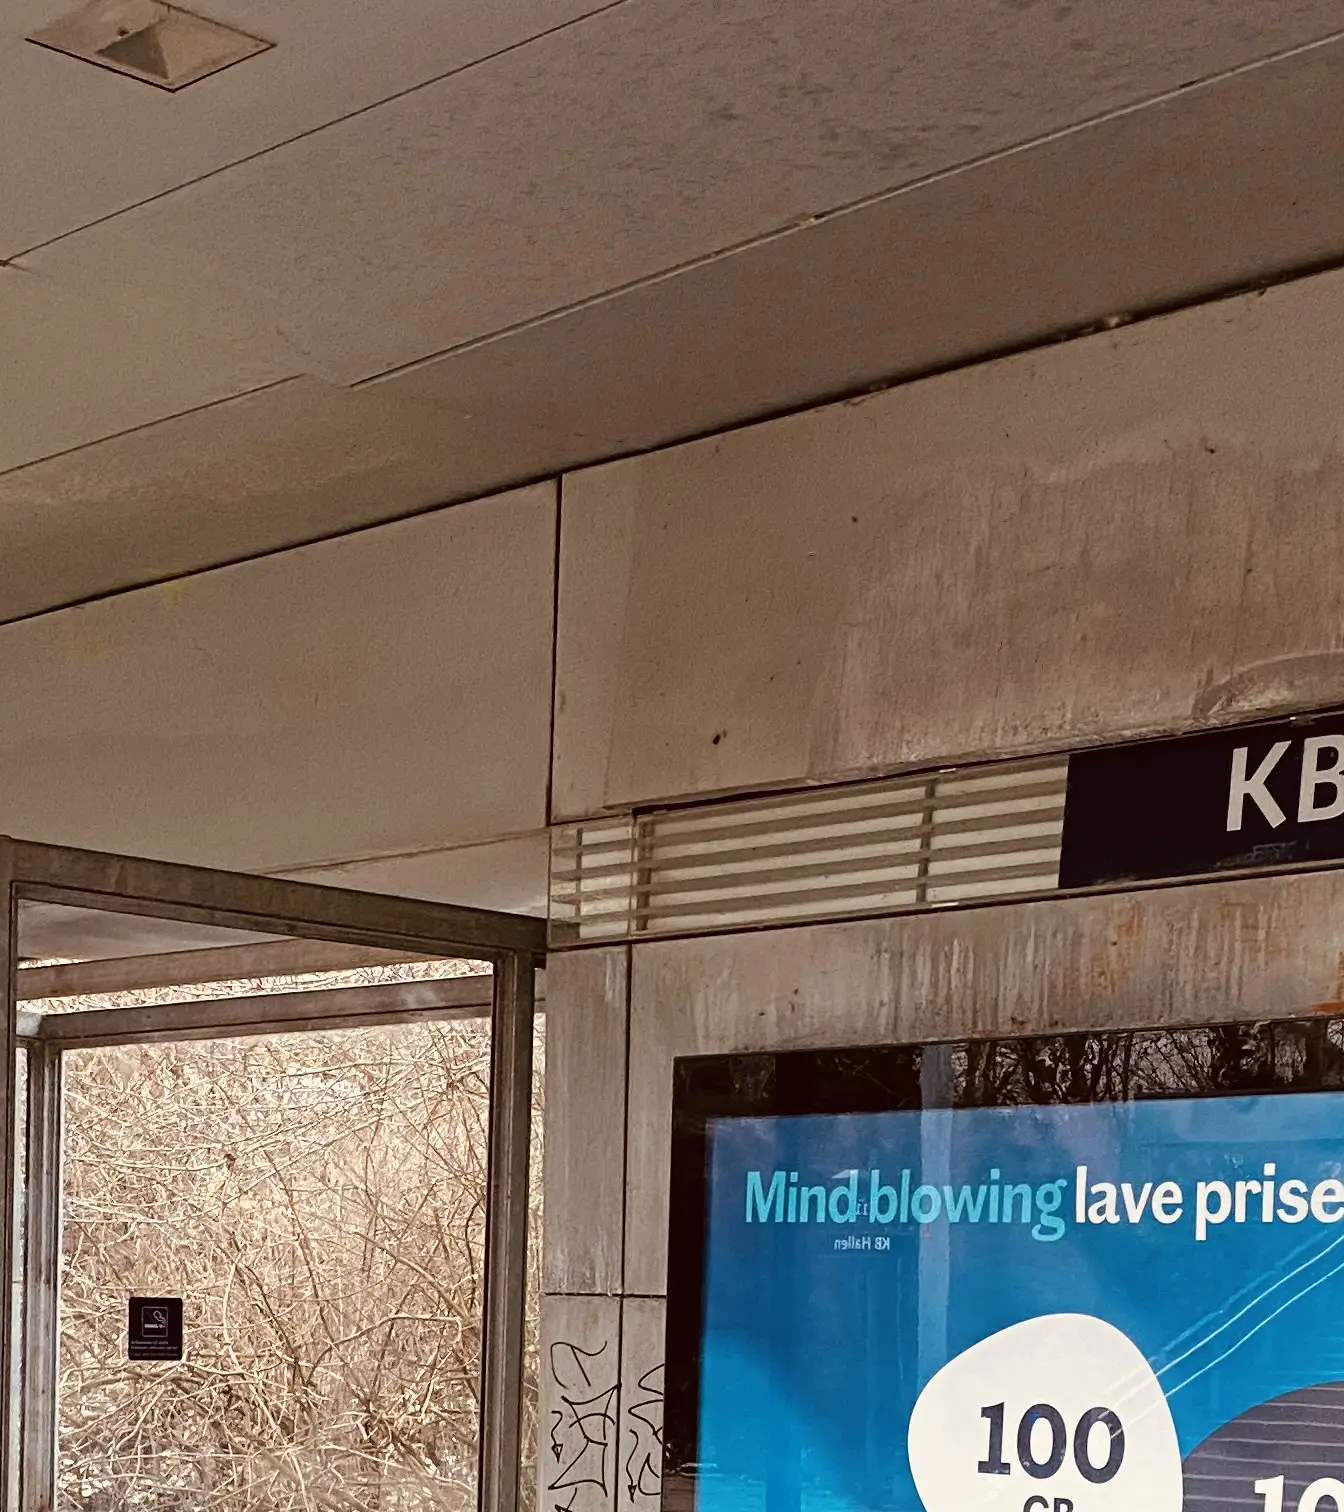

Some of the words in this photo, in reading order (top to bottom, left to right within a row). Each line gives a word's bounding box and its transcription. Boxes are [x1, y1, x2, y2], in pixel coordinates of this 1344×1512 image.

[744, 1168, 859, 1224] Mind
[868, 1167, 1068, 1242] blowing
[1075, 1164, 1183, 1224] lave
[976, 1401, 1125, 1484] 100
